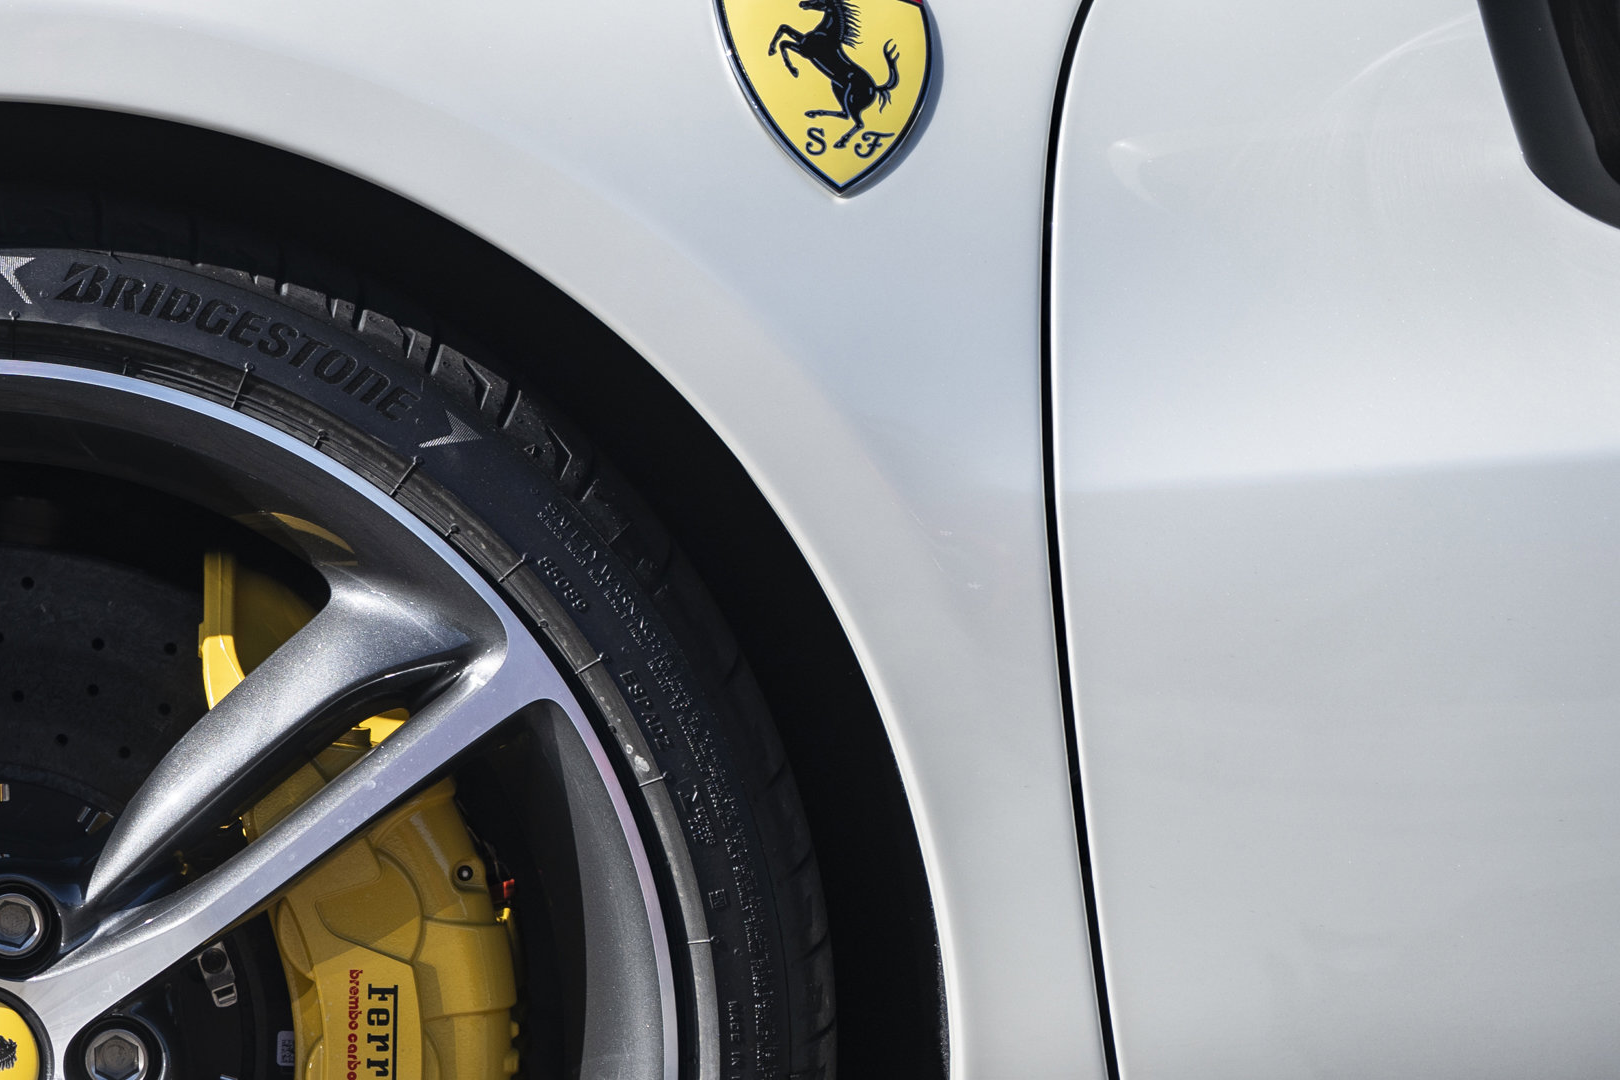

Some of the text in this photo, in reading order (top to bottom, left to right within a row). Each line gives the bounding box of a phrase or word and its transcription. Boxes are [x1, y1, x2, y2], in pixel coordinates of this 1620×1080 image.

[805, 127, 895, 159] S F
[53, 261, 423, 423] BRIDGESTONE
[347, 969, 363, 1031] brembo
